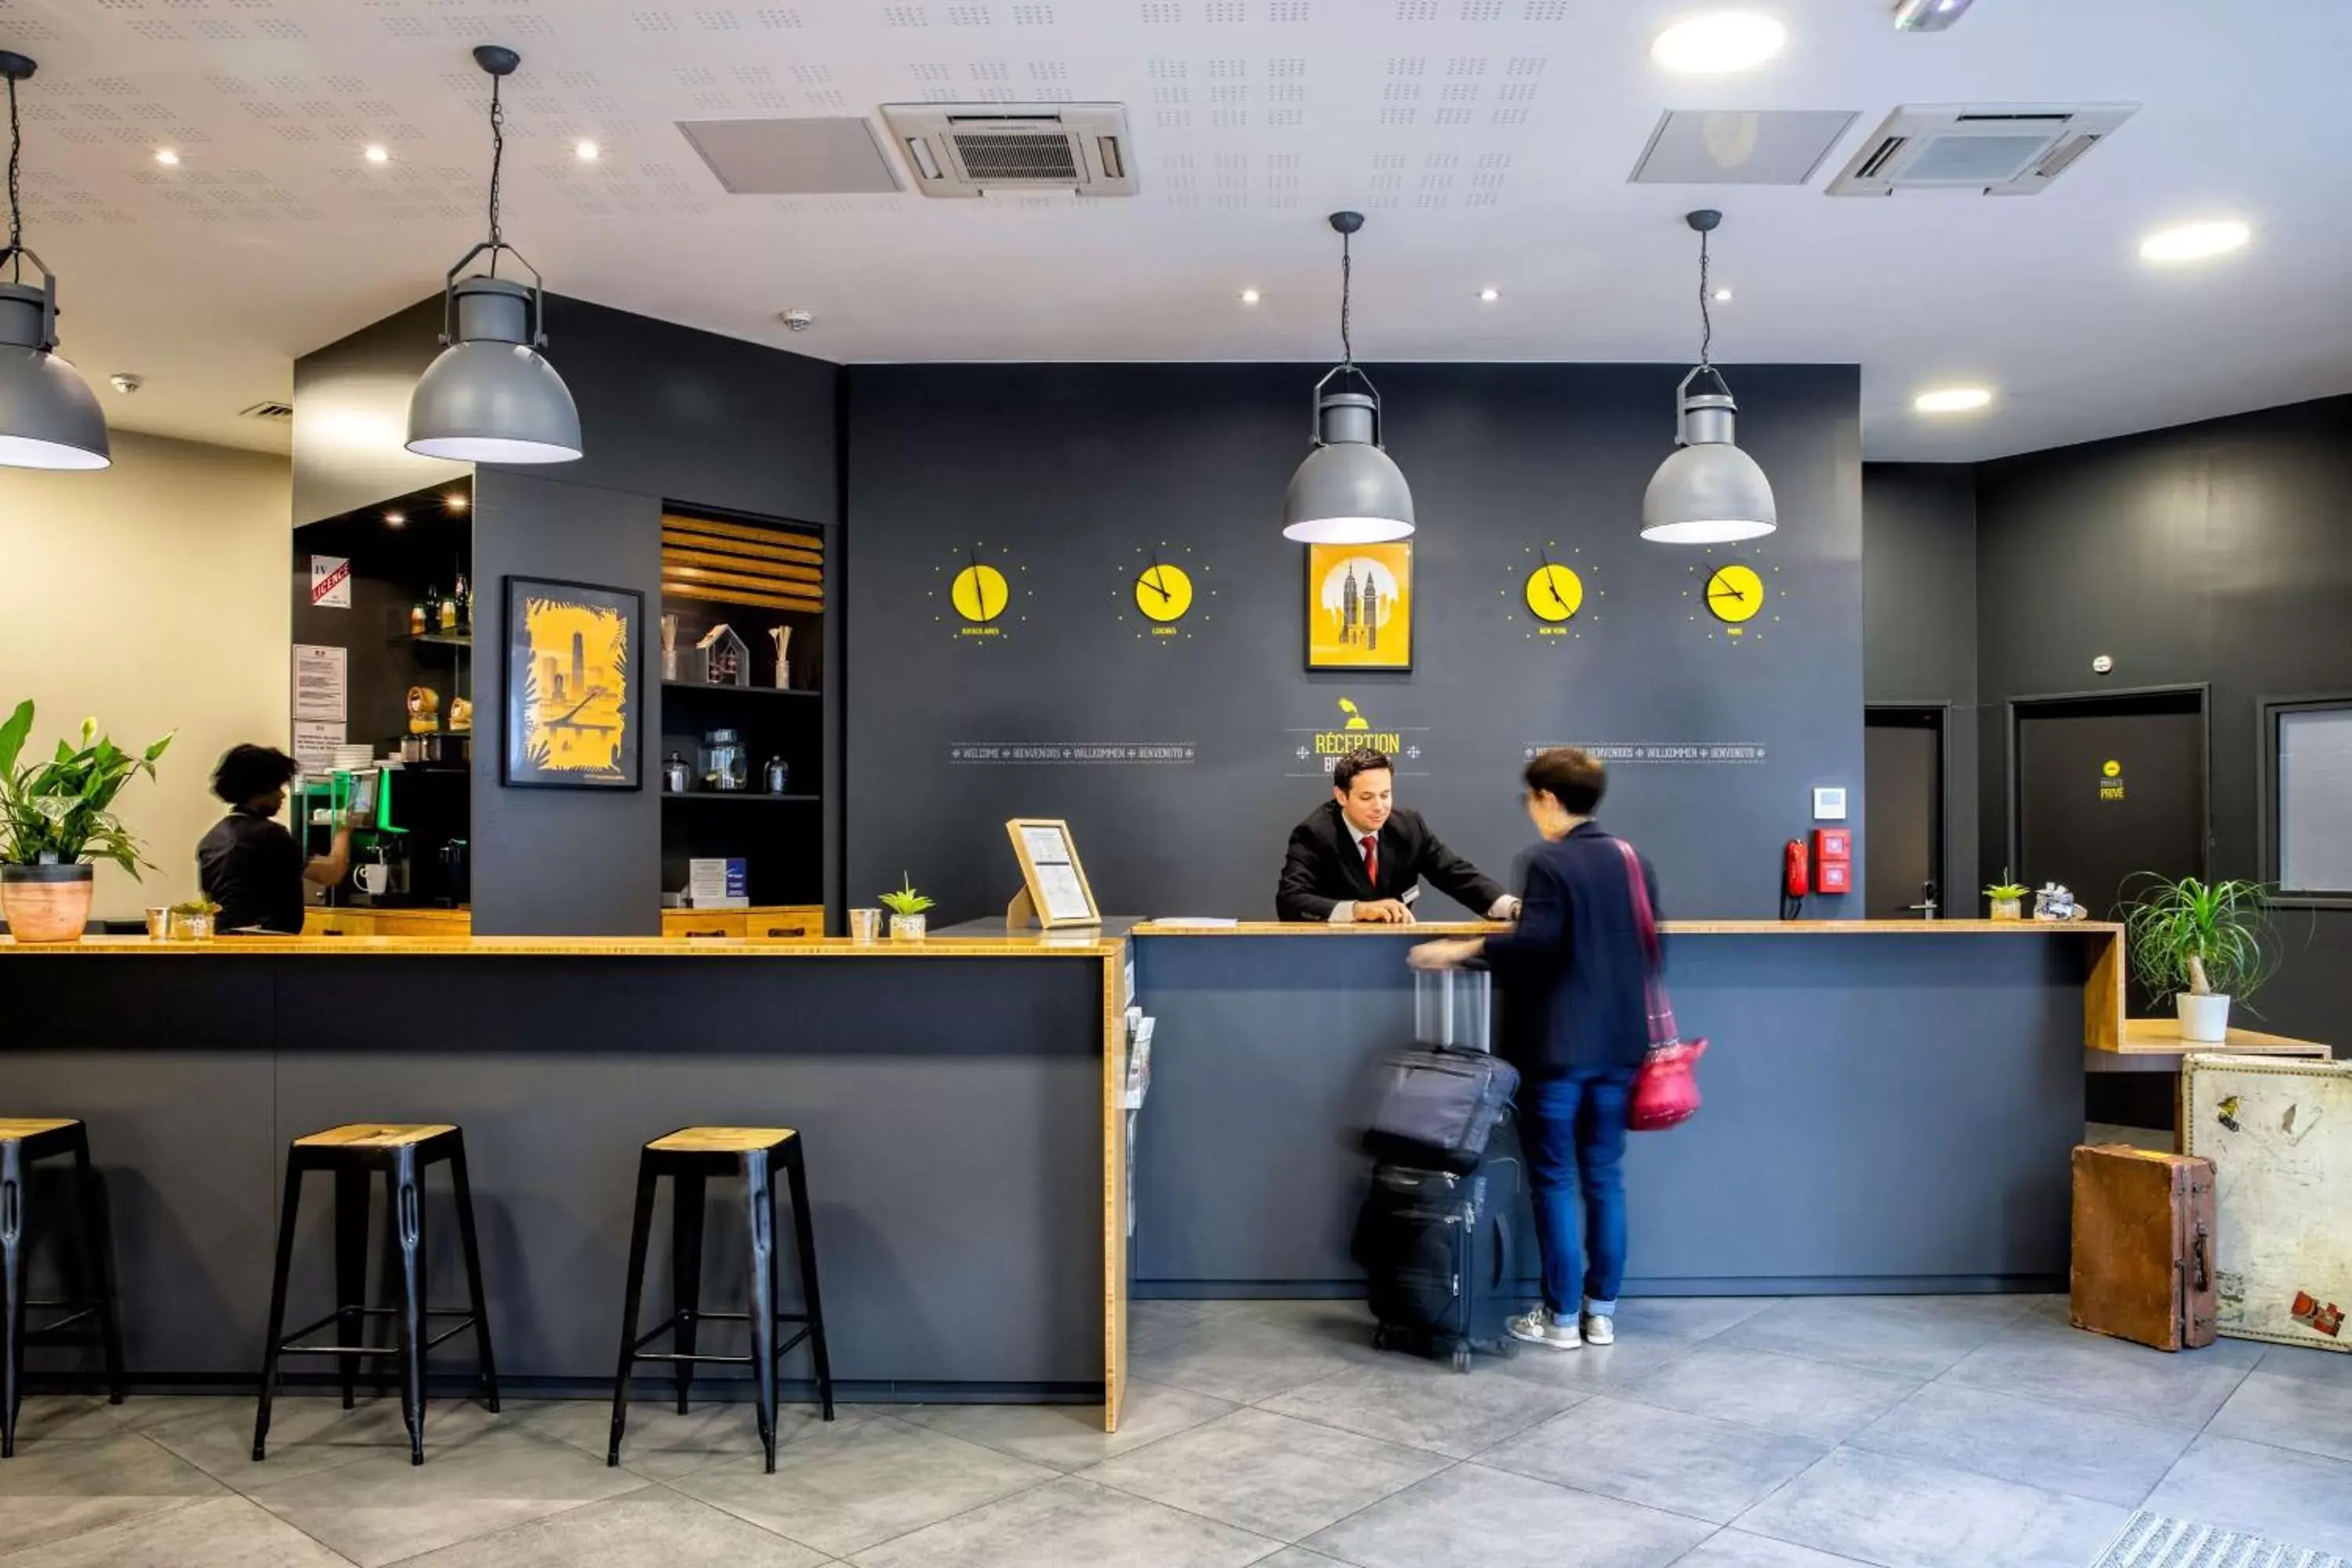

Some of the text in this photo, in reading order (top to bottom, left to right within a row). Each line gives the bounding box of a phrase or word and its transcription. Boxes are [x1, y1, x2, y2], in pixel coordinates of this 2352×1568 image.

[314, 564, 328, 575] IV
[1539, 627, 1568, 636] NEW YORK
[1315, 731, 1400, 754] RÉCEPTION
[963, 747, 1000, 759] WELCOME
[1073, 747, 1126, 759] WILLKOMMEN
[1646, 747, 1697, 759] WILLKOMMEN
[2100, 786, 2125, 800] PRIVÉ
